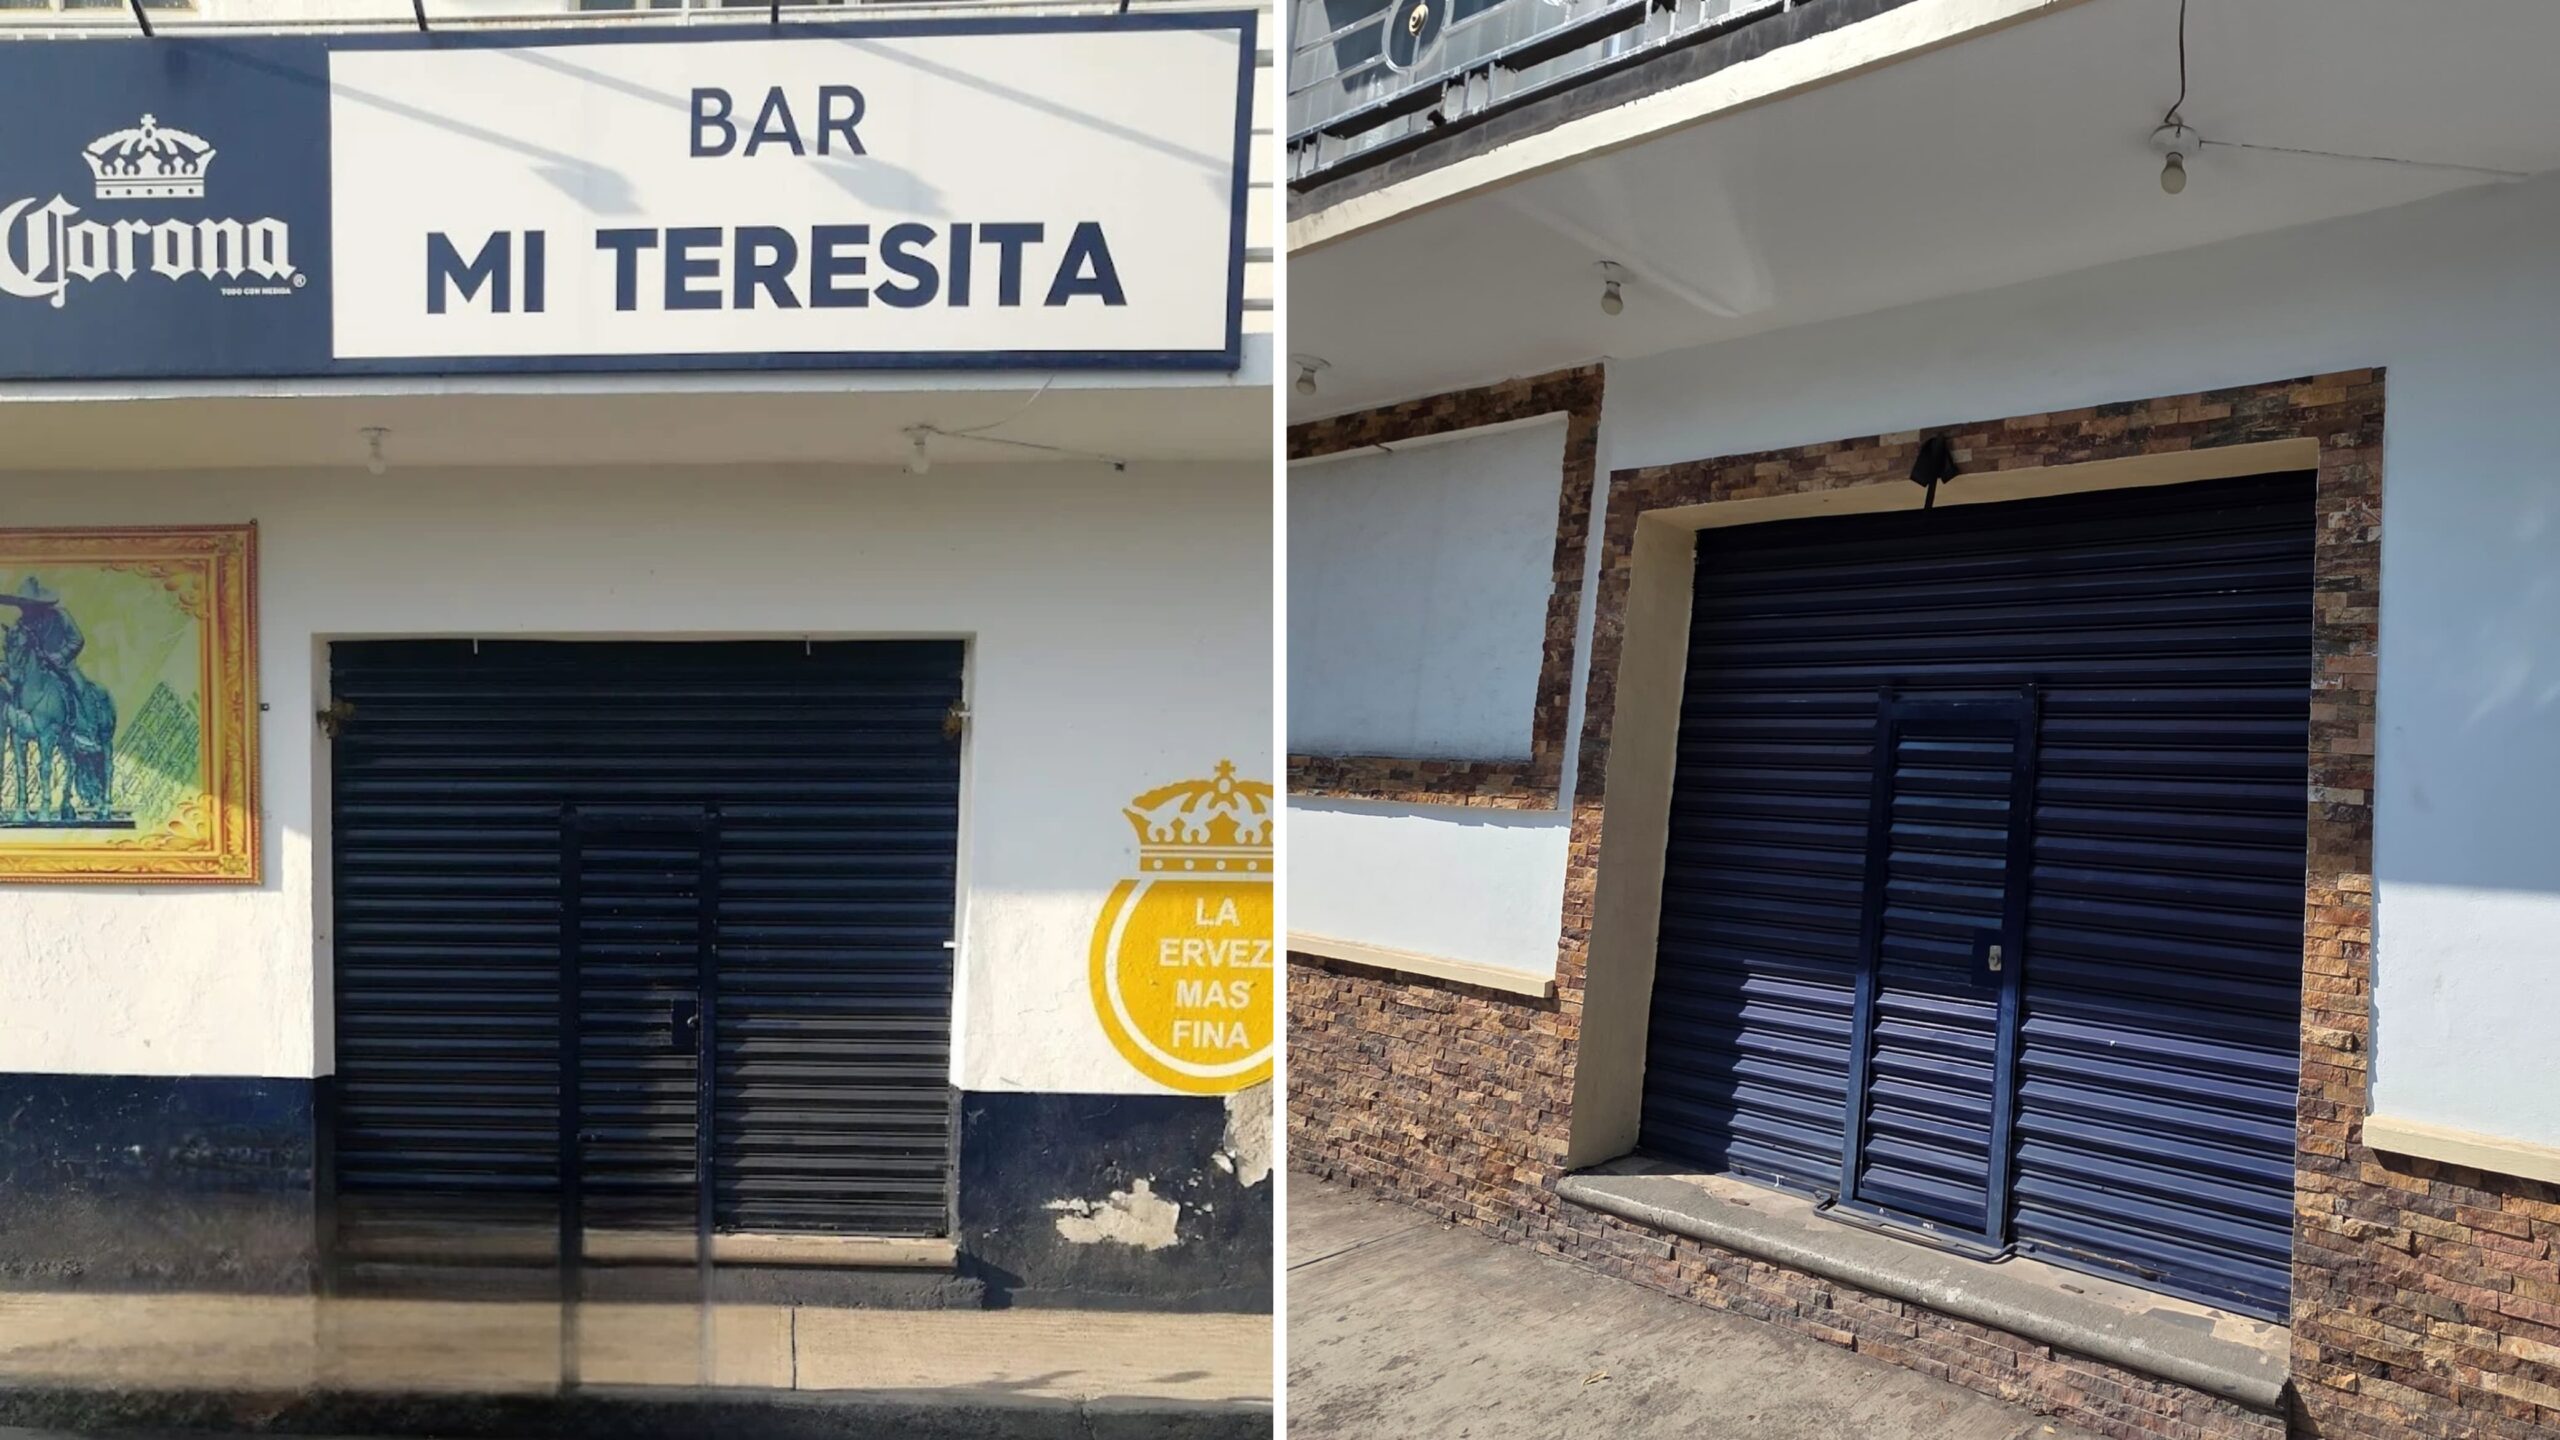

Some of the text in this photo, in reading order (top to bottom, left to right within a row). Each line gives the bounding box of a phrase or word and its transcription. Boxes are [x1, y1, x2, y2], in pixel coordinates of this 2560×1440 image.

[689, 85, 867, 158] BAR
[0, 194, 297, 308] Corona
[426, 221, 1127, 315] MI TERESITA
[243, 287, 260, 295] CON
[1196, 898, 1238, 926] LA
[1176, 979, 1249, 1009] MAS
[1172, 1020, 1250, 1049] FINA
